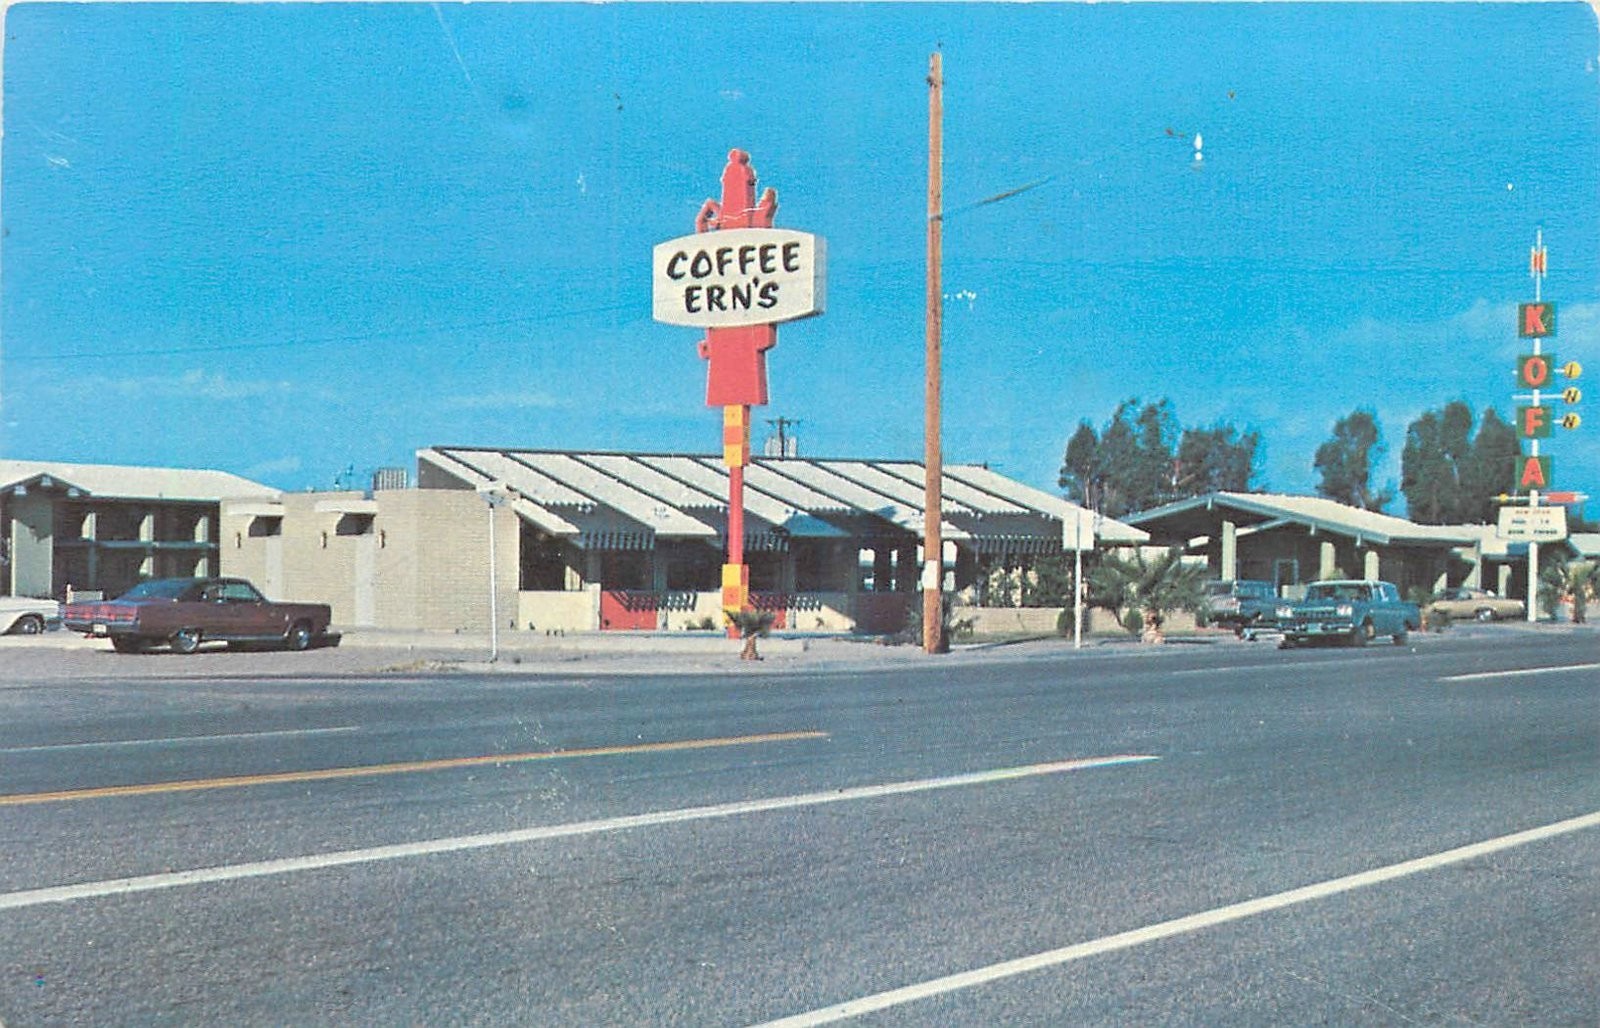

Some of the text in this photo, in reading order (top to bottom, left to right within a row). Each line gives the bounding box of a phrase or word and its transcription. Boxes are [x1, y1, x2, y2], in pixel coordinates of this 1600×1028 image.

[666, 242, 800, 280] COFFEE
[684, 276, 779, 313] ERN'S
[1521, 304, 1547, 486] KOFA
[1562, 363, 1579, 429] INN
